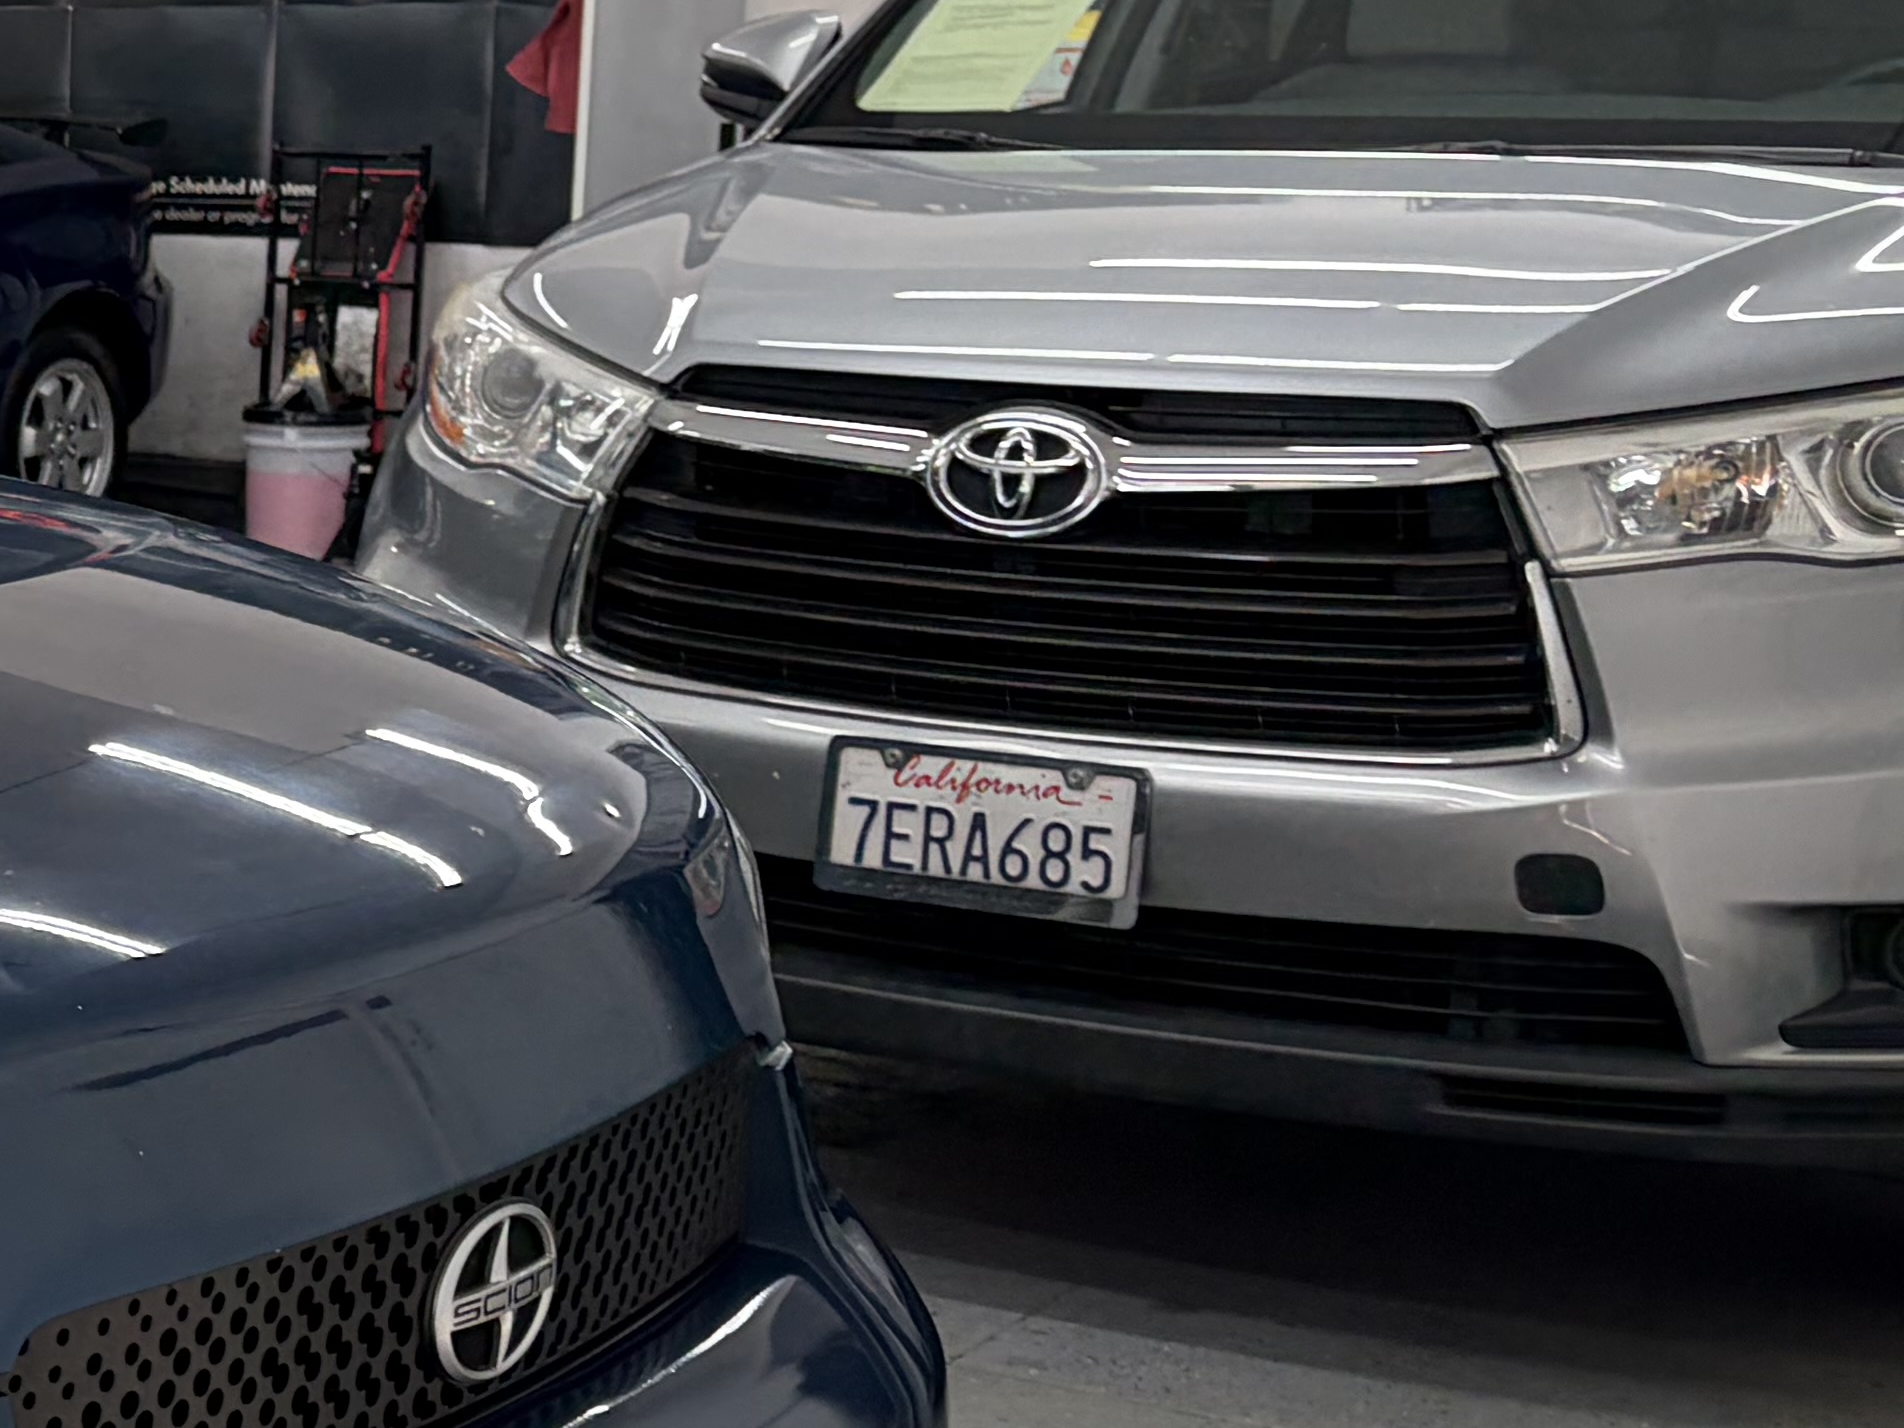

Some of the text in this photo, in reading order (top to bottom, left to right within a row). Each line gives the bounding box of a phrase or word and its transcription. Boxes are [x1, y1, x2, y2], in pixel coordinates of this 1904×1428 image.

[169, 175, 246, 195] Scheduled
[893, 754, 1082, 805] California
[847, 796, 1113, 894] 7ERA685
